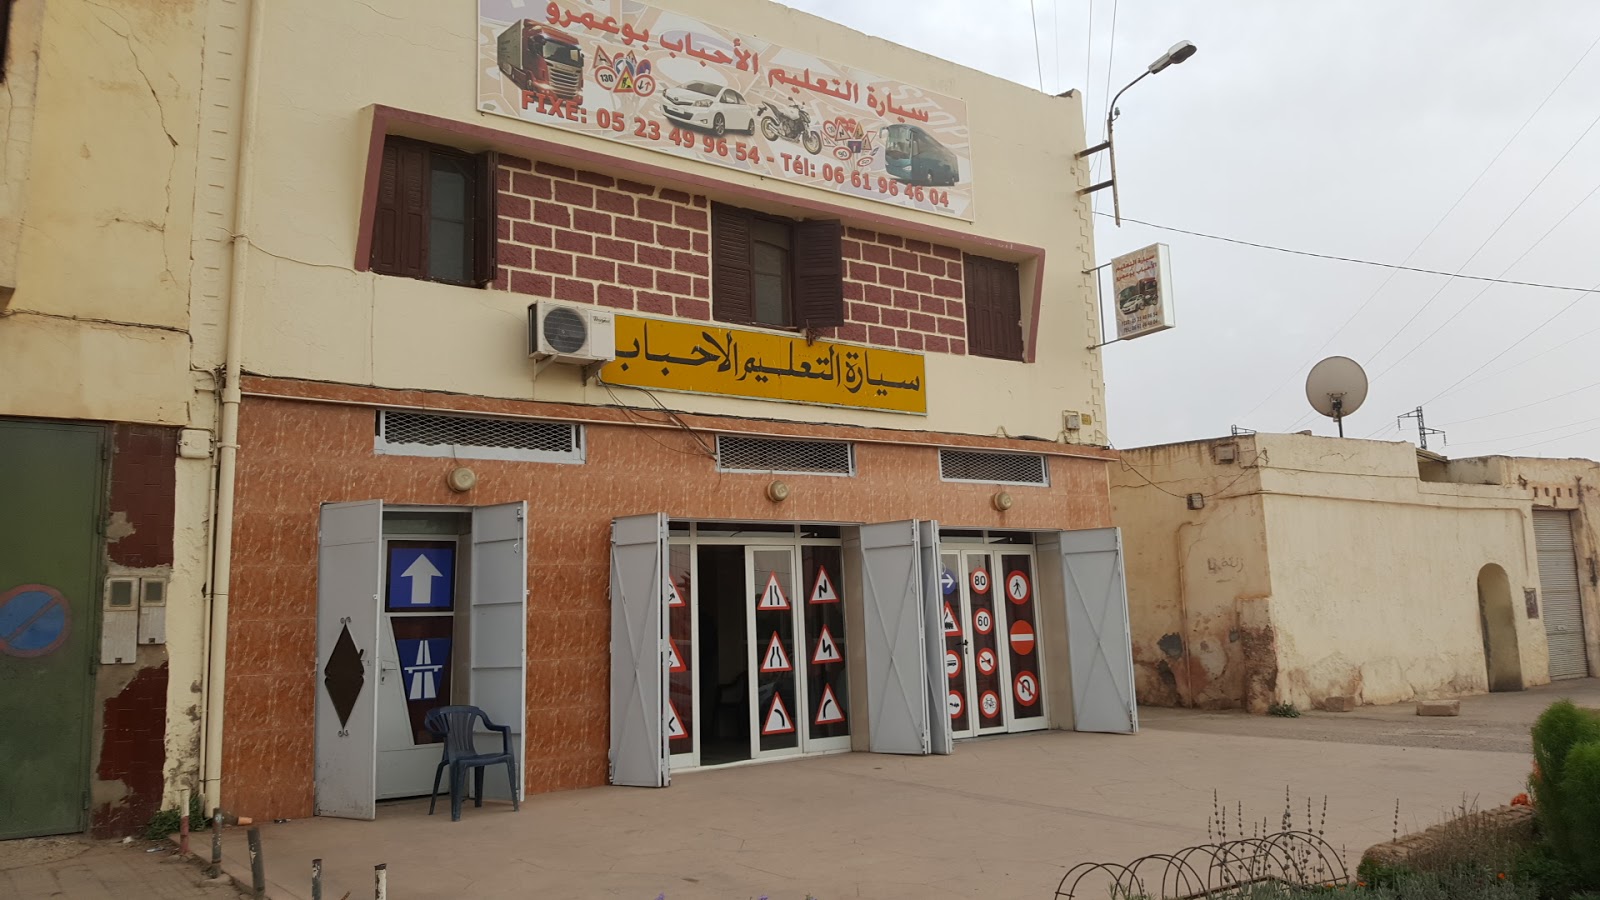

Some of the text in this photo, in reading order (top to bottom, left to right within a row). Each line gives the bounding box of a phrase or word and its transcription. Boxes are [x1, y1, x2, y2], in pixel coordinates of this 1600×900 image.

[659, 33, 758, 75] الأحباب
[768, 67, 859, 103] التعليم
[867, 85, 929, 123] سيارة
[521, 90, 587, 124] FIXE:
[596, 108, 625, 132] 05
[633, 117, 660, 141] 23
[668, 129, 695, 149] 49
[702, 135, 728, 157] 96
[735, 142, 760, 164] 54
[780, 152, 816, 178] Tél:
[822, 163, 845, 184] 06
[851, 170, 871, 191] 61
[877, 176, 899, 196] 96
[904, 183, 924, 202] 46
[929, 188, 949, 207] 04
[838, 150, 848, 158] 90
[615, 321, 920, 397] سيارة التعليم الاحباب
[974, 575, 986, 586] 80
[977, 615, 989, 627] 60
